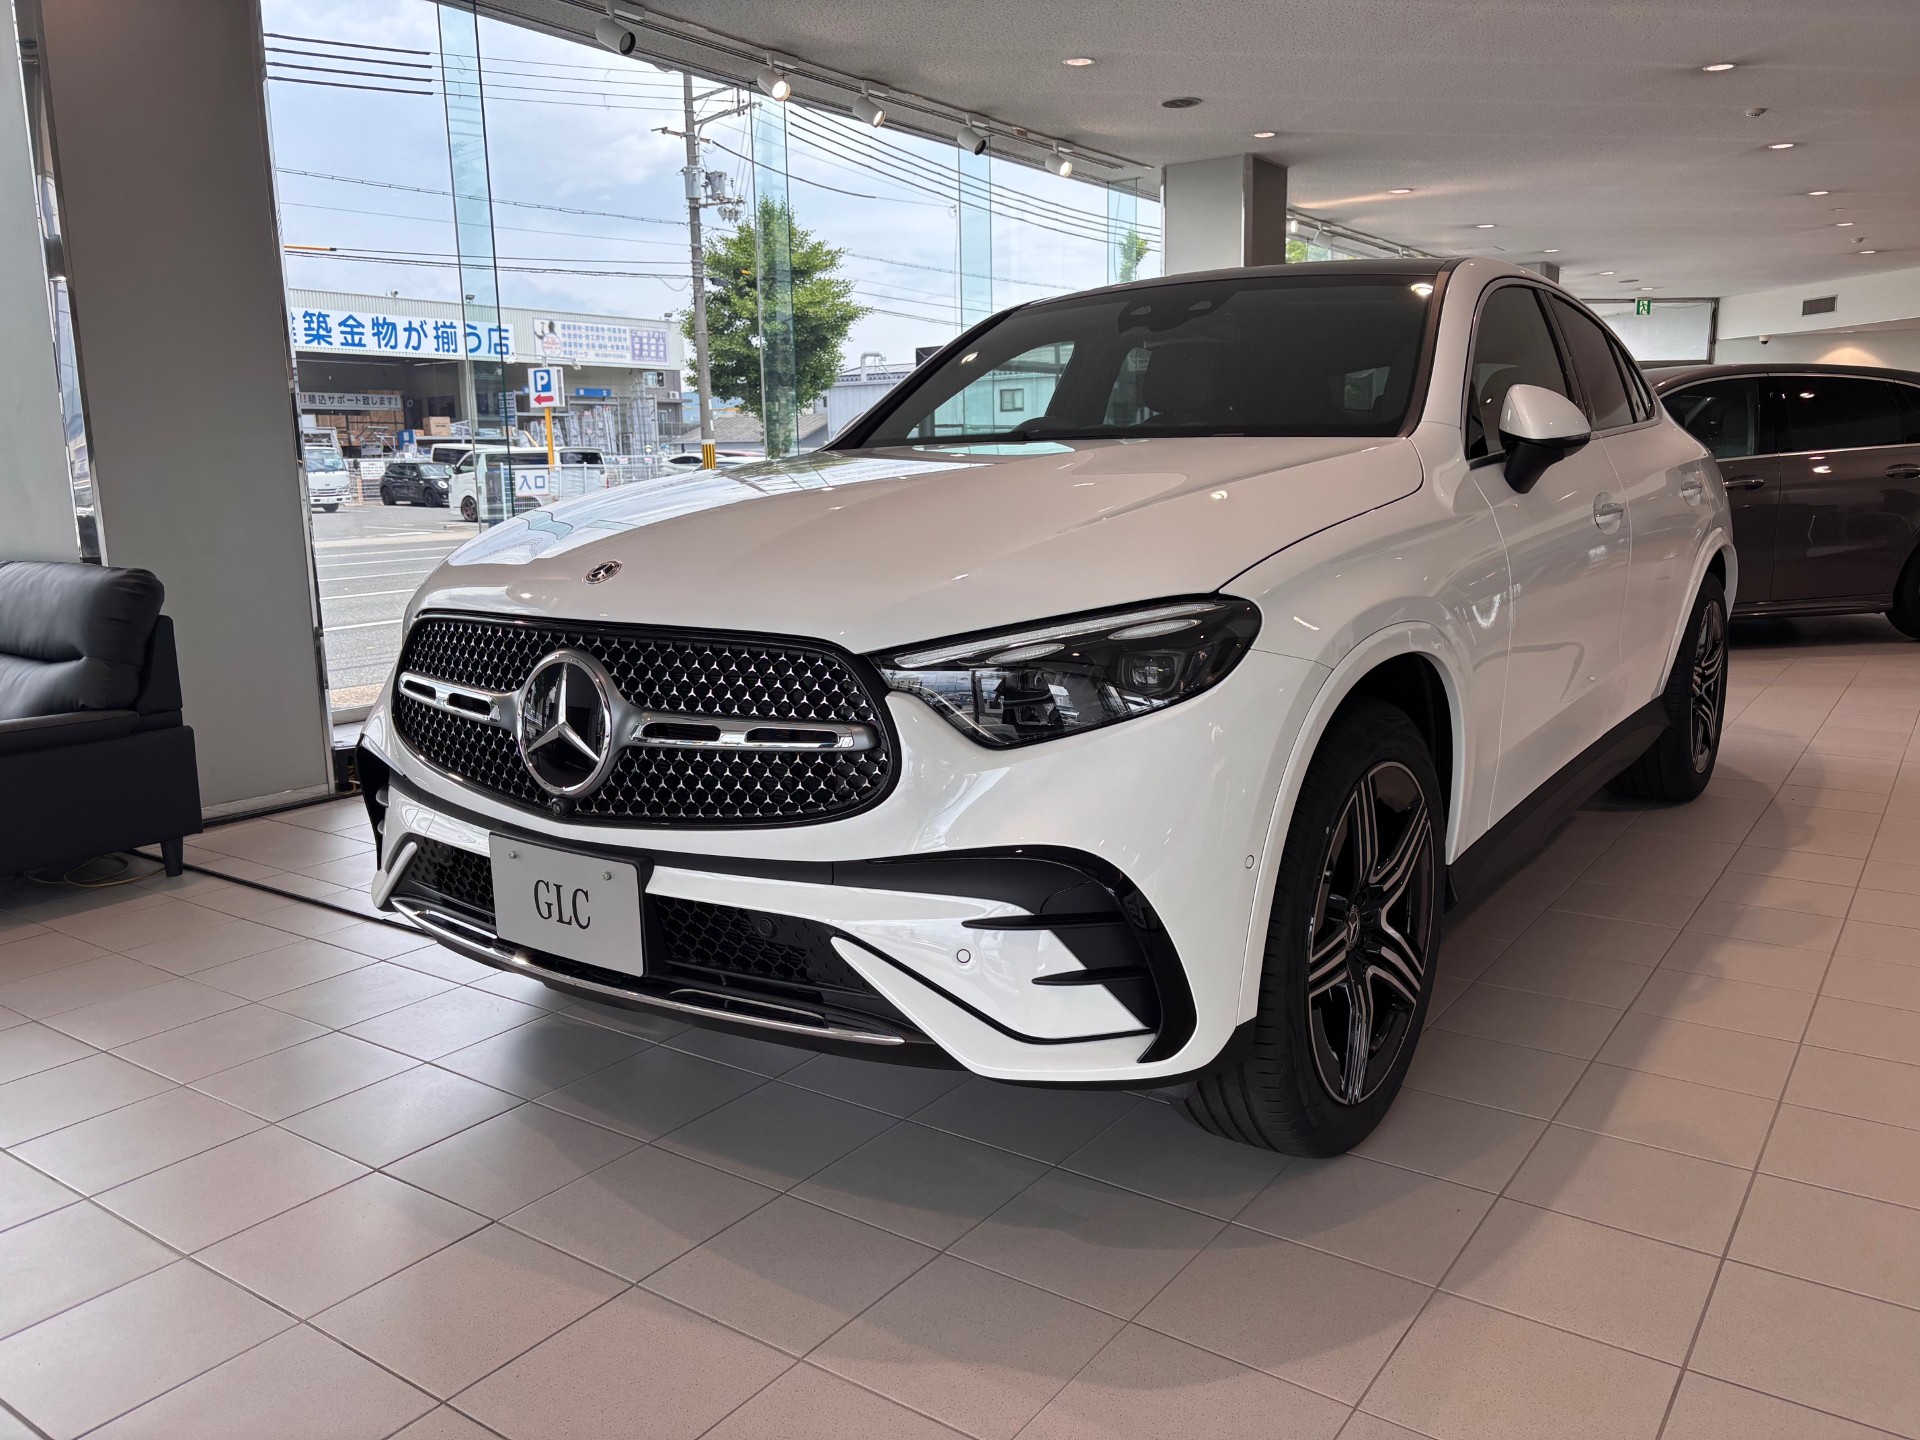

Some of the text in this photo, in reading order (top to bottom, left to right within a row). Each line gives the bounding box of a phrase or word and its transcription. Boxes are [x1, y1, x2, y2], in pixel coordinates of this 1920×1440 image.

[291, 310, 510, 356] 築金物が揃う店
[536, 371, 549, 391] P
[519, 475, 546, 491] 入口
[534, 879, 591, 930] GLC
